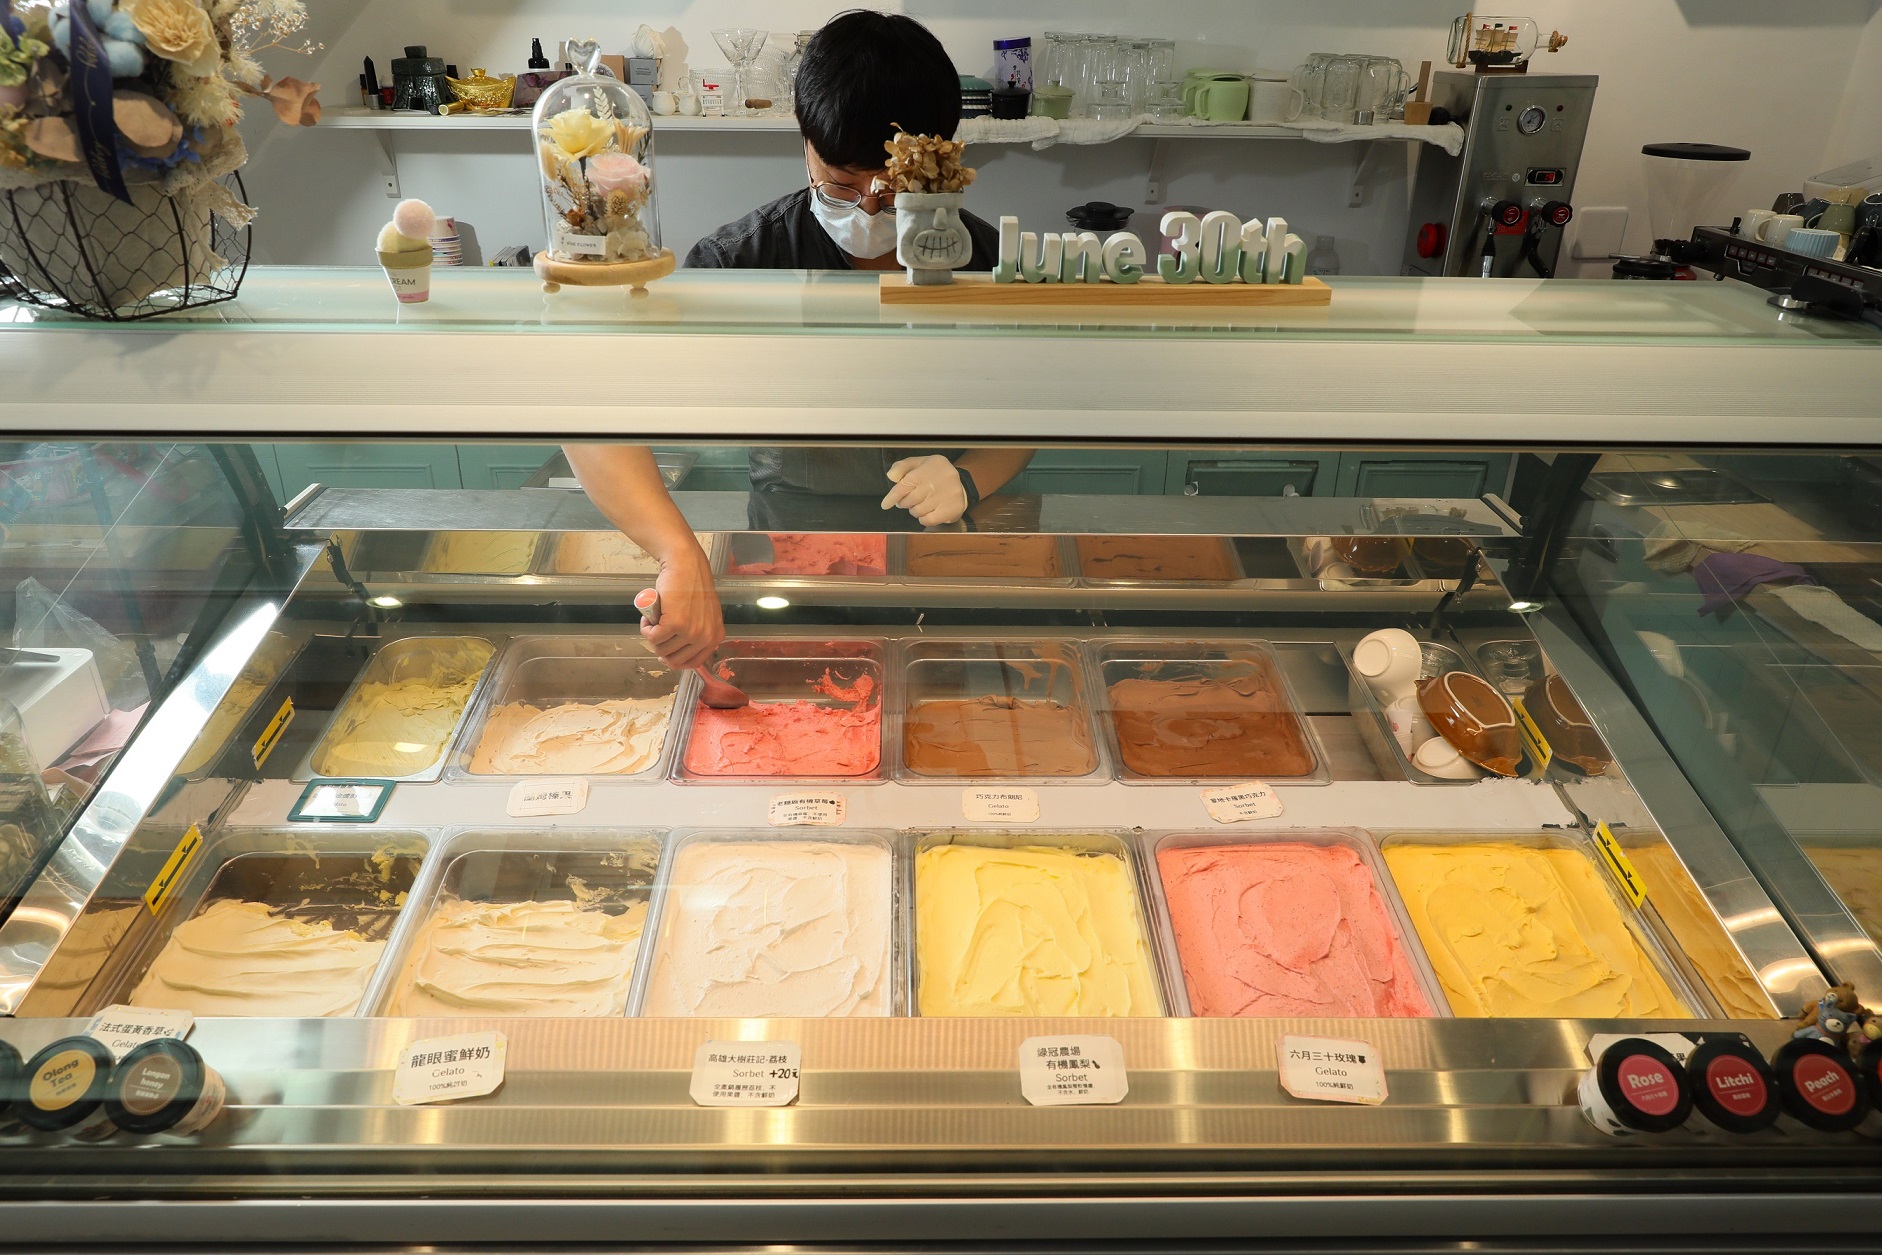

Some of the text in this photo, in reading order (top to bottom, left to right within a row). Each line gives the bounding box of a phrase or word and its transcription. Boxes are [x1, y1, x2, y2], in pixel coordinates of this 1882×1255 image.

[993, 210, 1306, 284] June 30th
[100, 1022, 166, 1035] 法式蛋黃香草
[411, 1046, 490, 1068] 龍眼蜜鮮奶
[1037, 1046, 1081, 1058] 綠冠農場
[1290, 1049, 1357, 1064] 六月三十玫瑰
[43, 1059, 78, 1081] Olong
[1046, 1059, 1091, 1070] 有機鳳梨
[432, 1067, 465, 1078] Gelato
[733, 1069, 764, 1078] Sorbet
[1055, 1073, 1088, 1083] Sorbet
[1315, 1067, 1347, 1077] Gelato
[1627, 1072, 1664, 1089] Rose
[1715, 1073, 1754, 1088] Litchi
[1804, 1070, 1840, 1093] Peach
